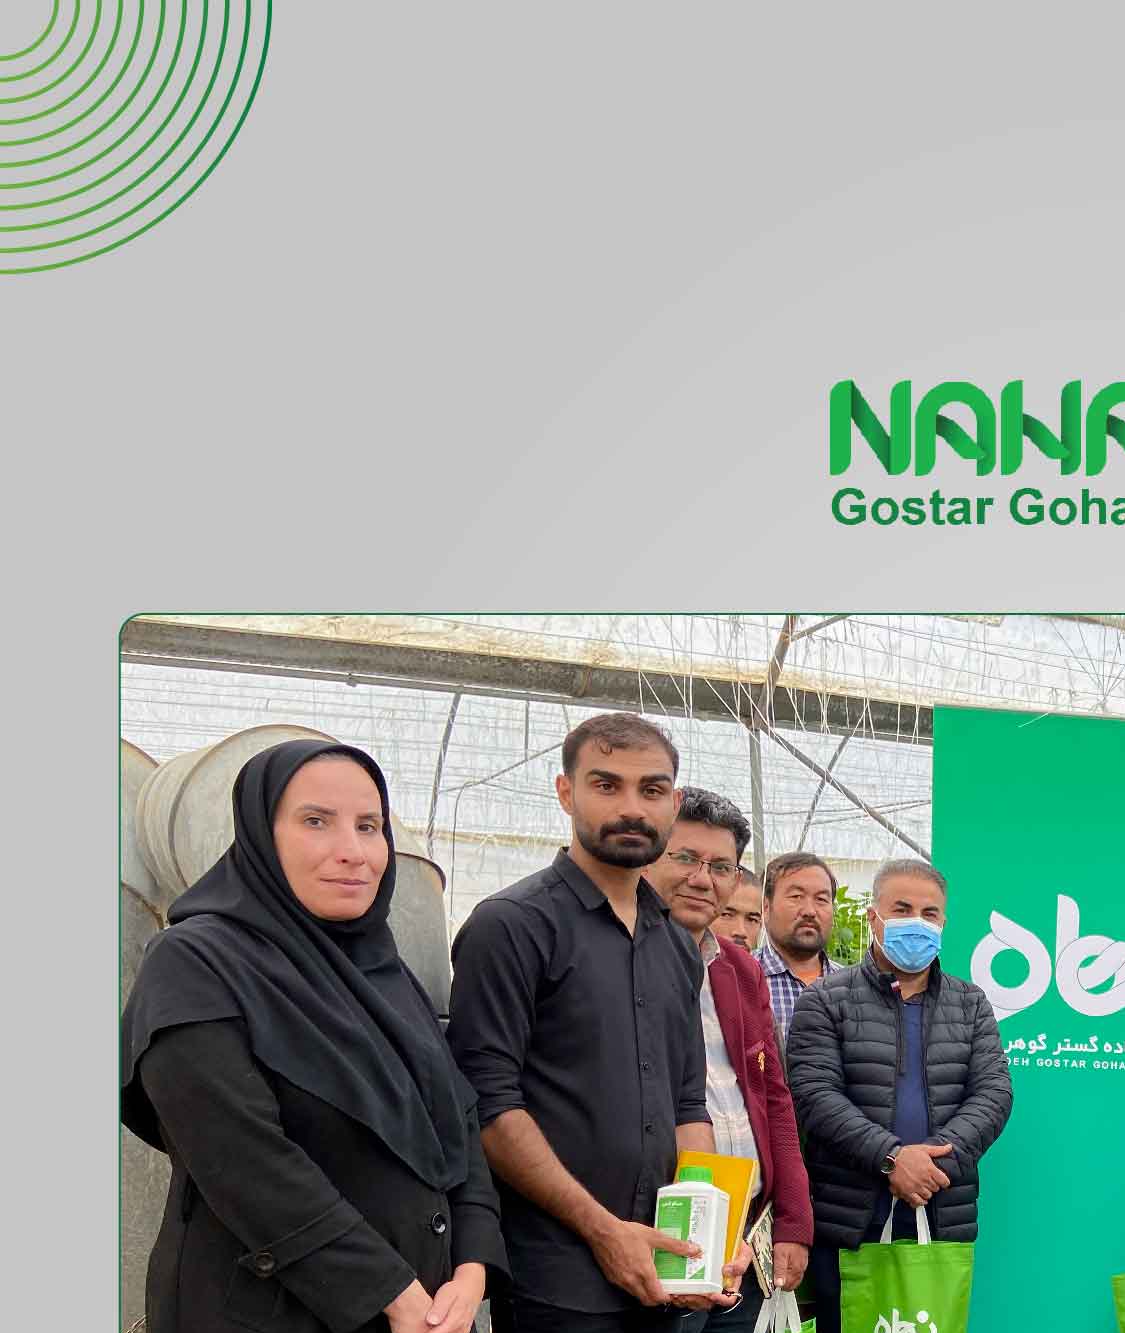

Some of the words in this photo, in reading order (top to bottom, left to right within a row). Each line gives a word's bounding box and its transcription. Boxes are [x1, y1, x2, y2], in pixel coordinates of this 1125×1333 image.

[1004, 1033, 1047, 1055] گوهر
[1052, 1035, 1099, 1056] گستر
[1036, 1057, 1087, 1069] GOSTAR
